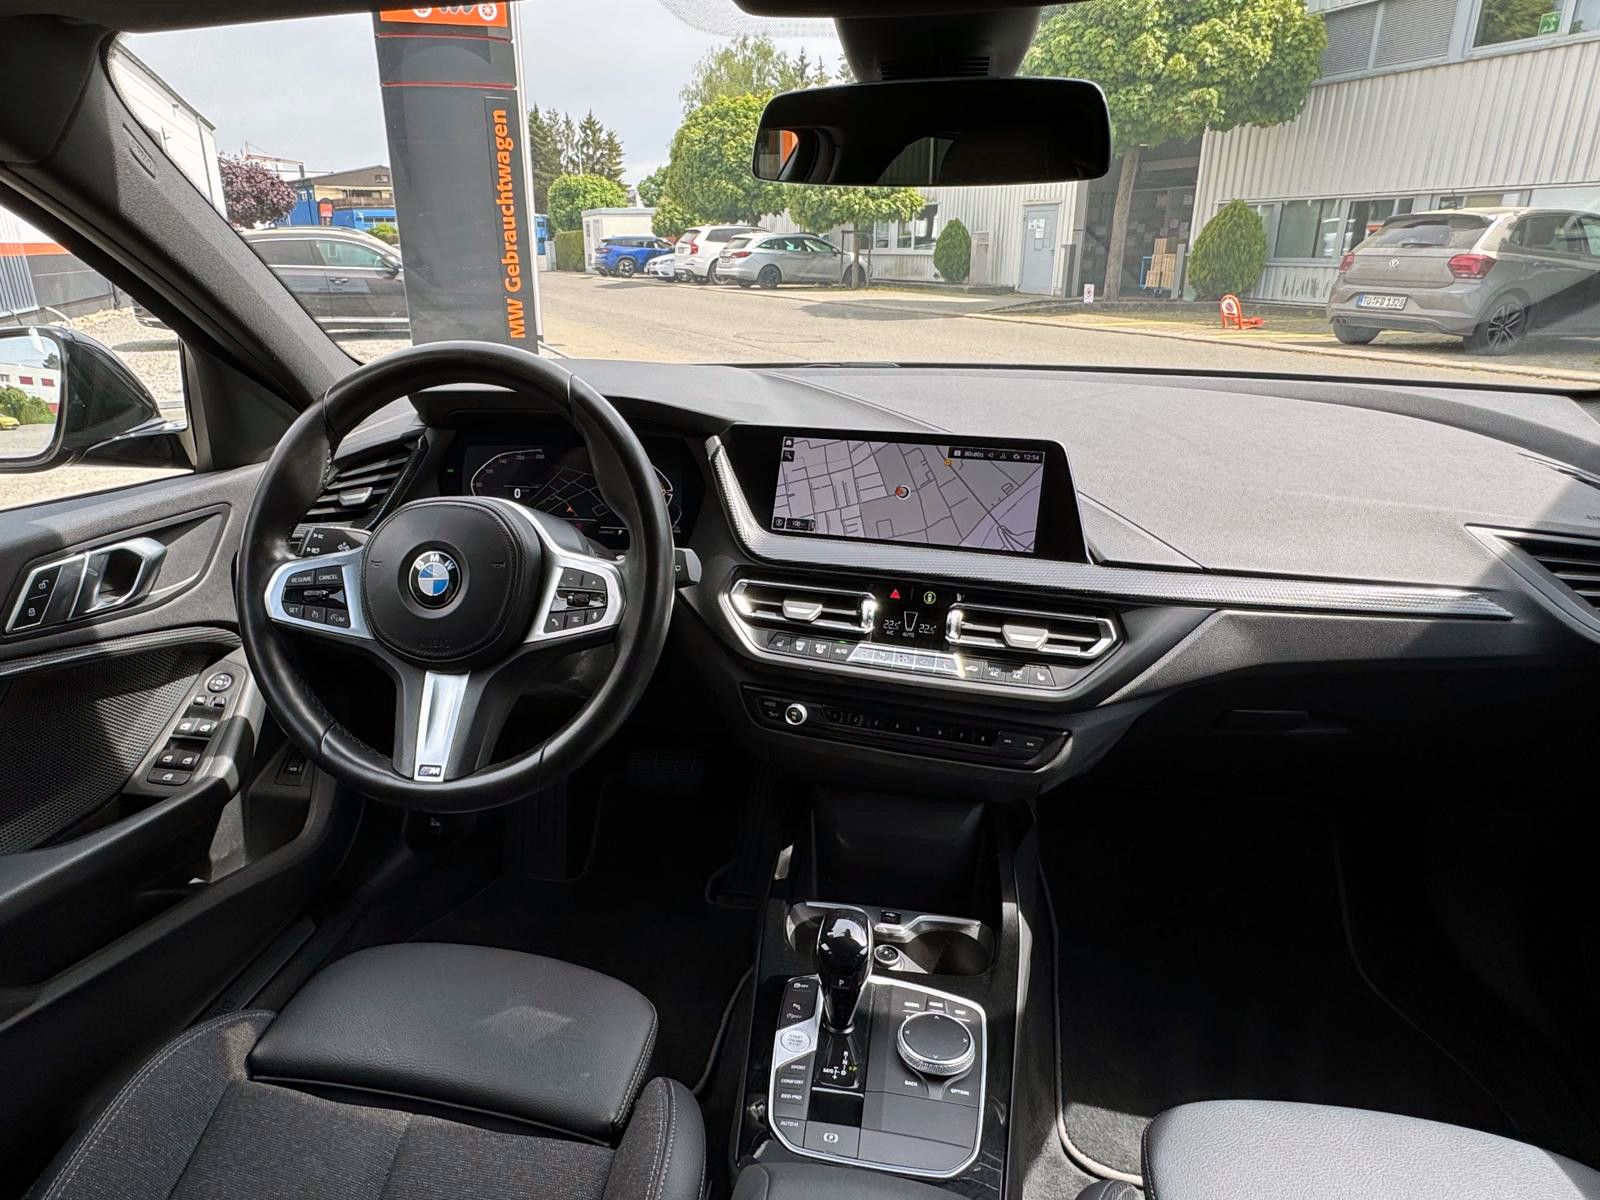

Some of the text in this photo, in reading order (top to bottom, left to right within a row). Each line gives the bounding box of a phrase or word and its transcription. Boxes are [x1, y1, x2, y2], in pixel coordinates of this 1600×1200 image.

[493, 109, 522, 293] Gebrauchtwagen
[513, 487, 521, 499] 0
[414, 552, 456, 571] BMW
[291, 575, 312, 583] RESUME
[318, 573, 338, 581] CANCEL
[288, 606, 299, 614] SET
[834, 647, 848, 655] AUTO
[904, 1079, 918, 1088] BACK
[950, 1088, 970, 1096] OPTION
